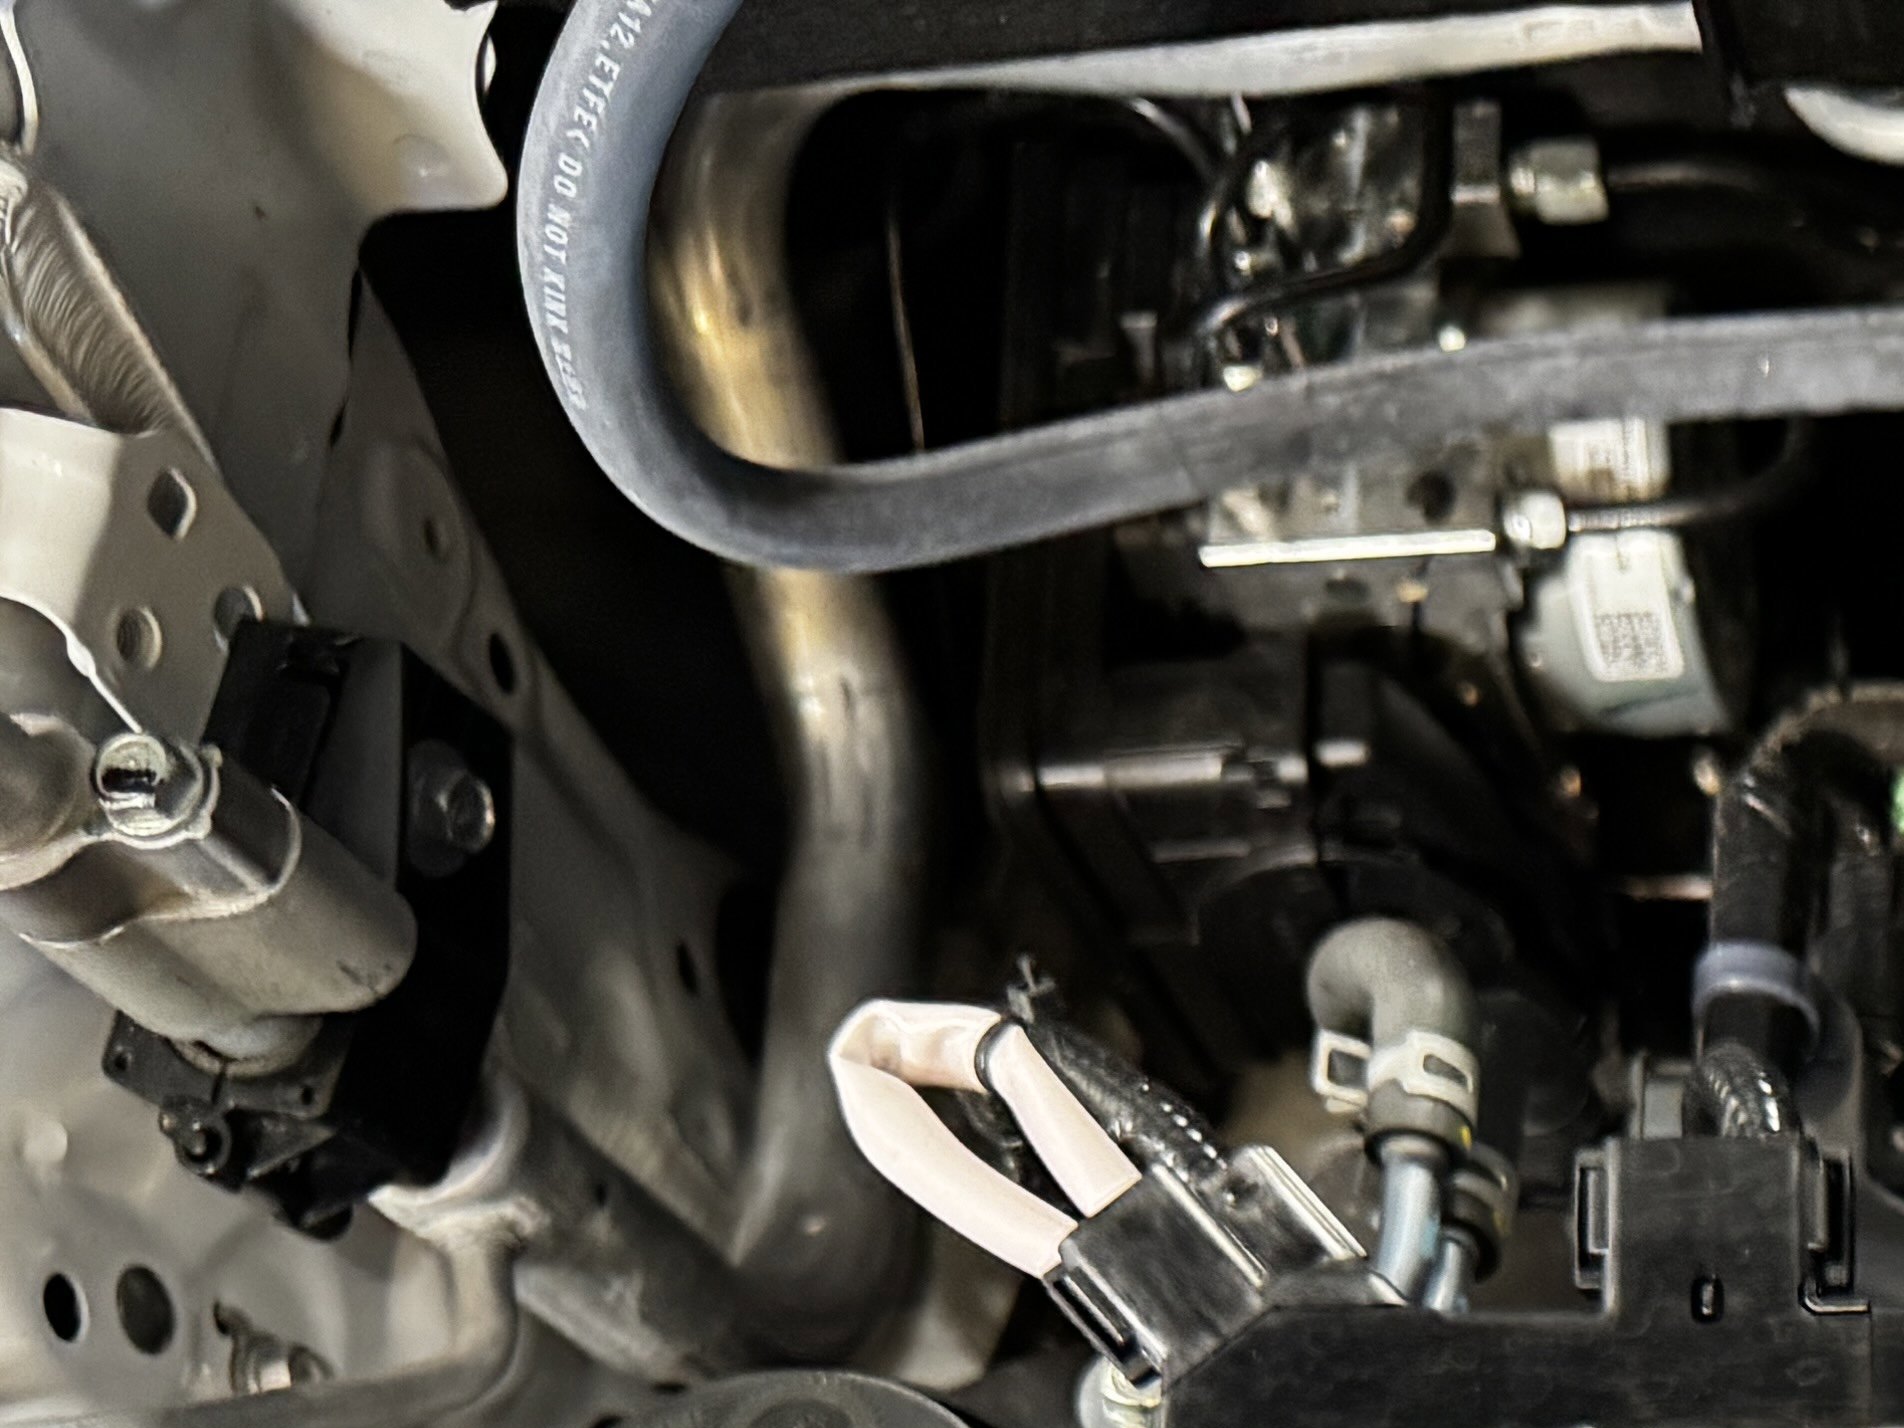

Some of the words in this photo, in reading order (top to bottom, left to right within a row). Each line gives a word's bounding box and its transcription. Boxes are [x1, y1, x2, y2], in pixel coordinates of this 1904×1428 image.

[553, 153, 583, 199] DO
[543, 204, 571, 265] NOT
[543, 267, 569, 334] KINK
